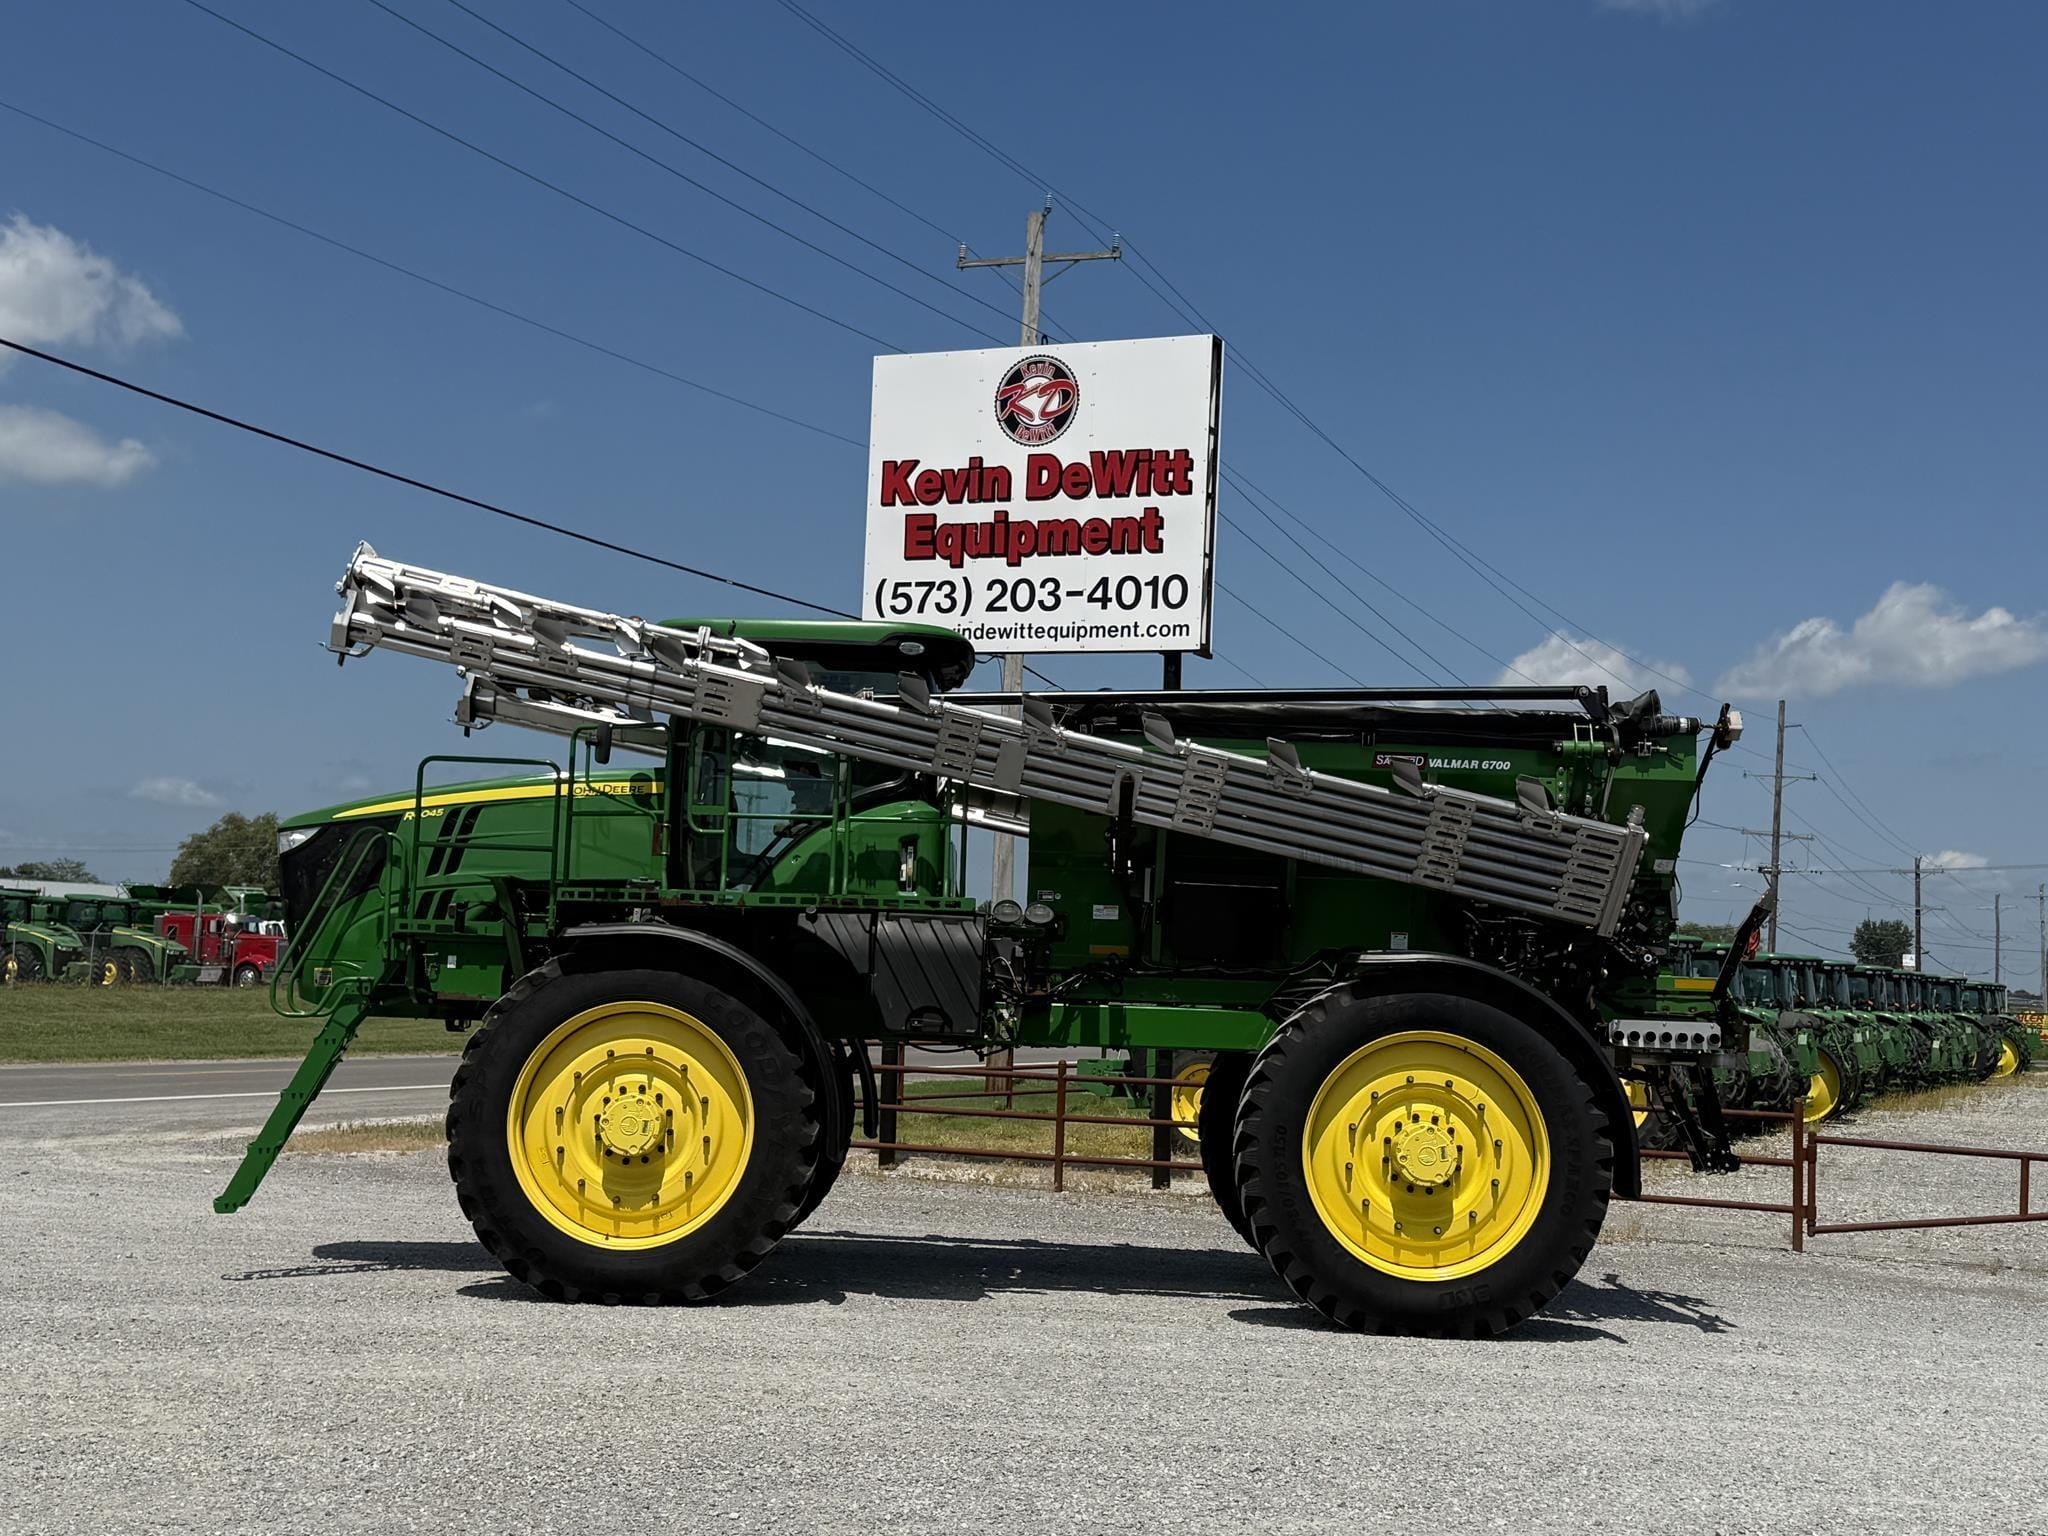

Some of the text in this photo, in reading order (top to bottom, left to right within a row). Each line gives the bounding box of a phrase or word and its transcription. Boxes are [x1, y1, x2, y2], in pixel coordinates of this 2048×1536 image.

[1020, 360, 1056, 377] Kevin
[880, 448, 1194, 506] Kevin DeWitt
[904, 506, 1164, 569] Equipment
[874, 574, 1189, 618] (573) 203-4010
[1428, 758, 1511, 770] VALMAR 6700
[403, 808, 445, 821] R045
